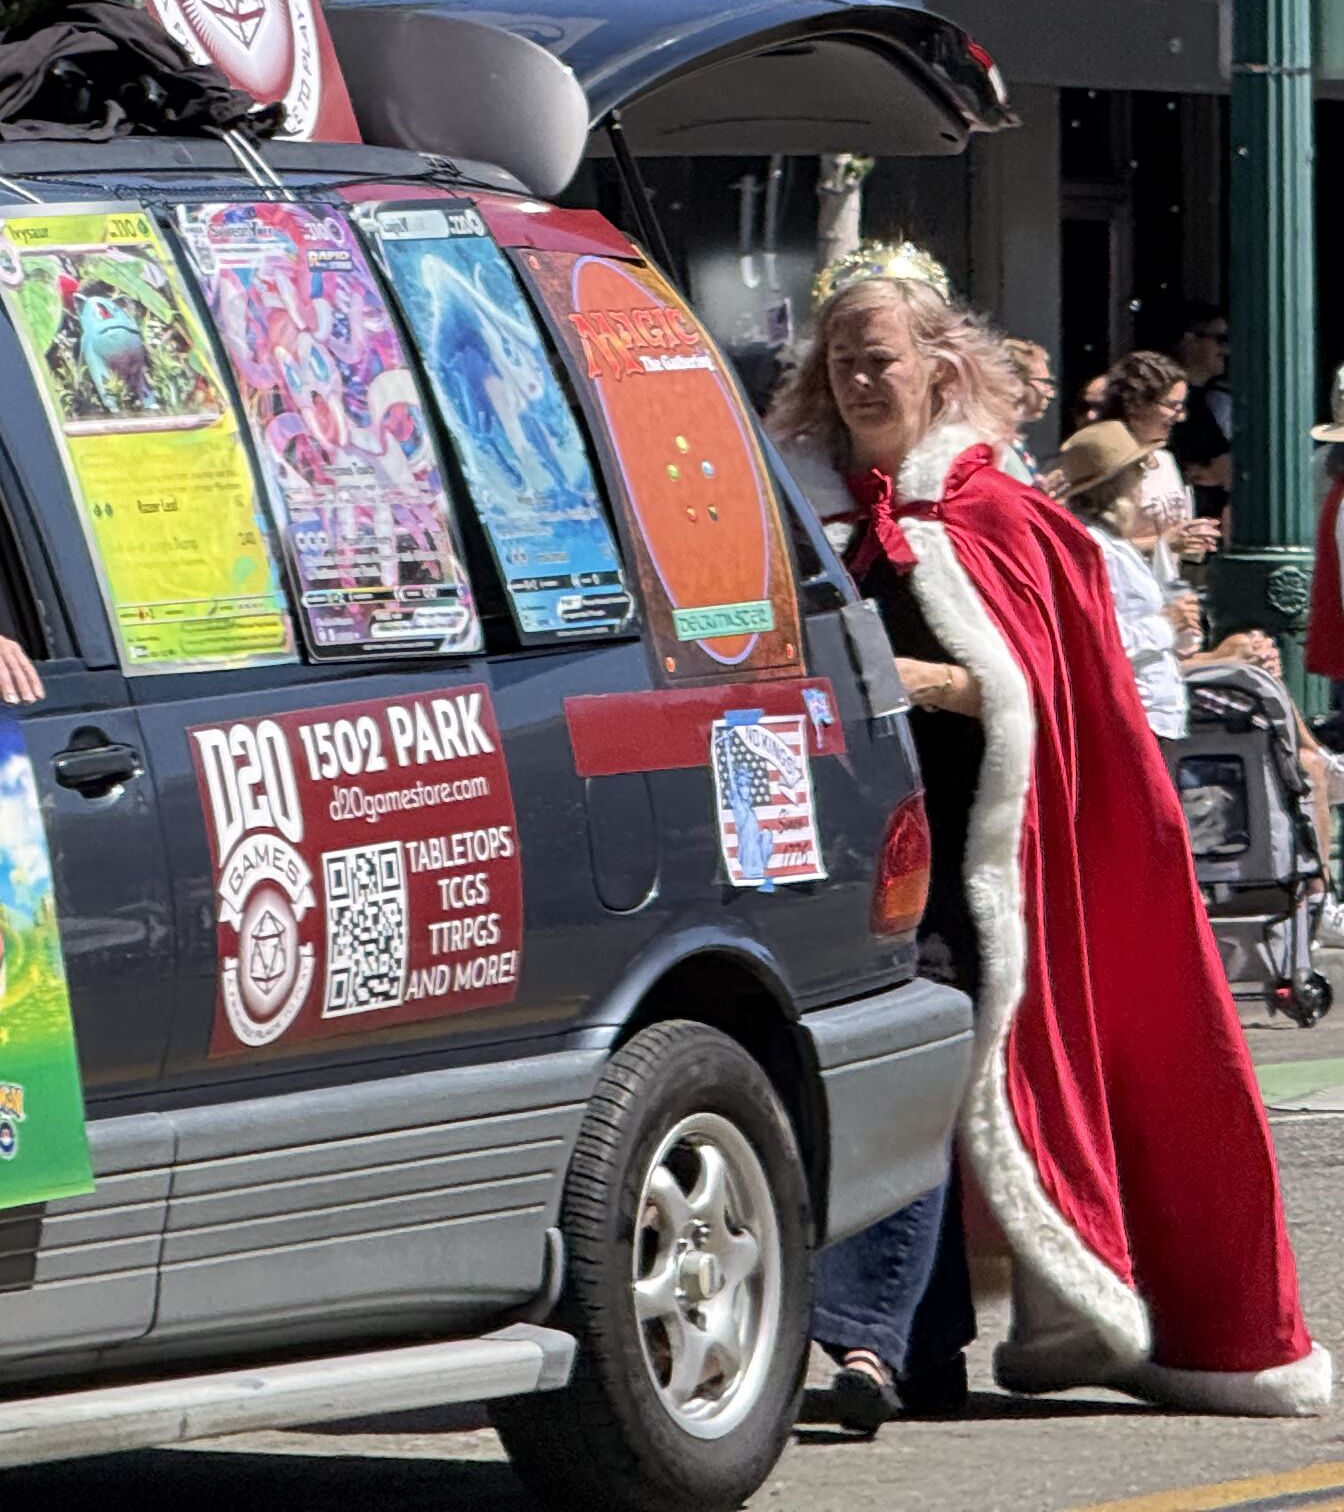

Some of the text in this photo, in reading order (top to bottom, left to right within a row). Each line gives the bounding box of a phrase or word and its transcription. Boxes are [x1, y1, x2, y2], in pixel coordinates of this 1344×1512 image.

[567, 308, 700, 382] MAGIC
[298, 692, 495, 782] 1502 PARK
[193, 719, 305, 868] D20
[328, 776, 490, 824] d20gamestore.com
[228, 843, 300, 896] GAMES
[405, 826, 514, 873] TABLETOPS
[437, 872, 490, 911] TCGS
[428, 912, 502, 956] TTRPGS
[404, 949, 521, 1002] AND MORE!
